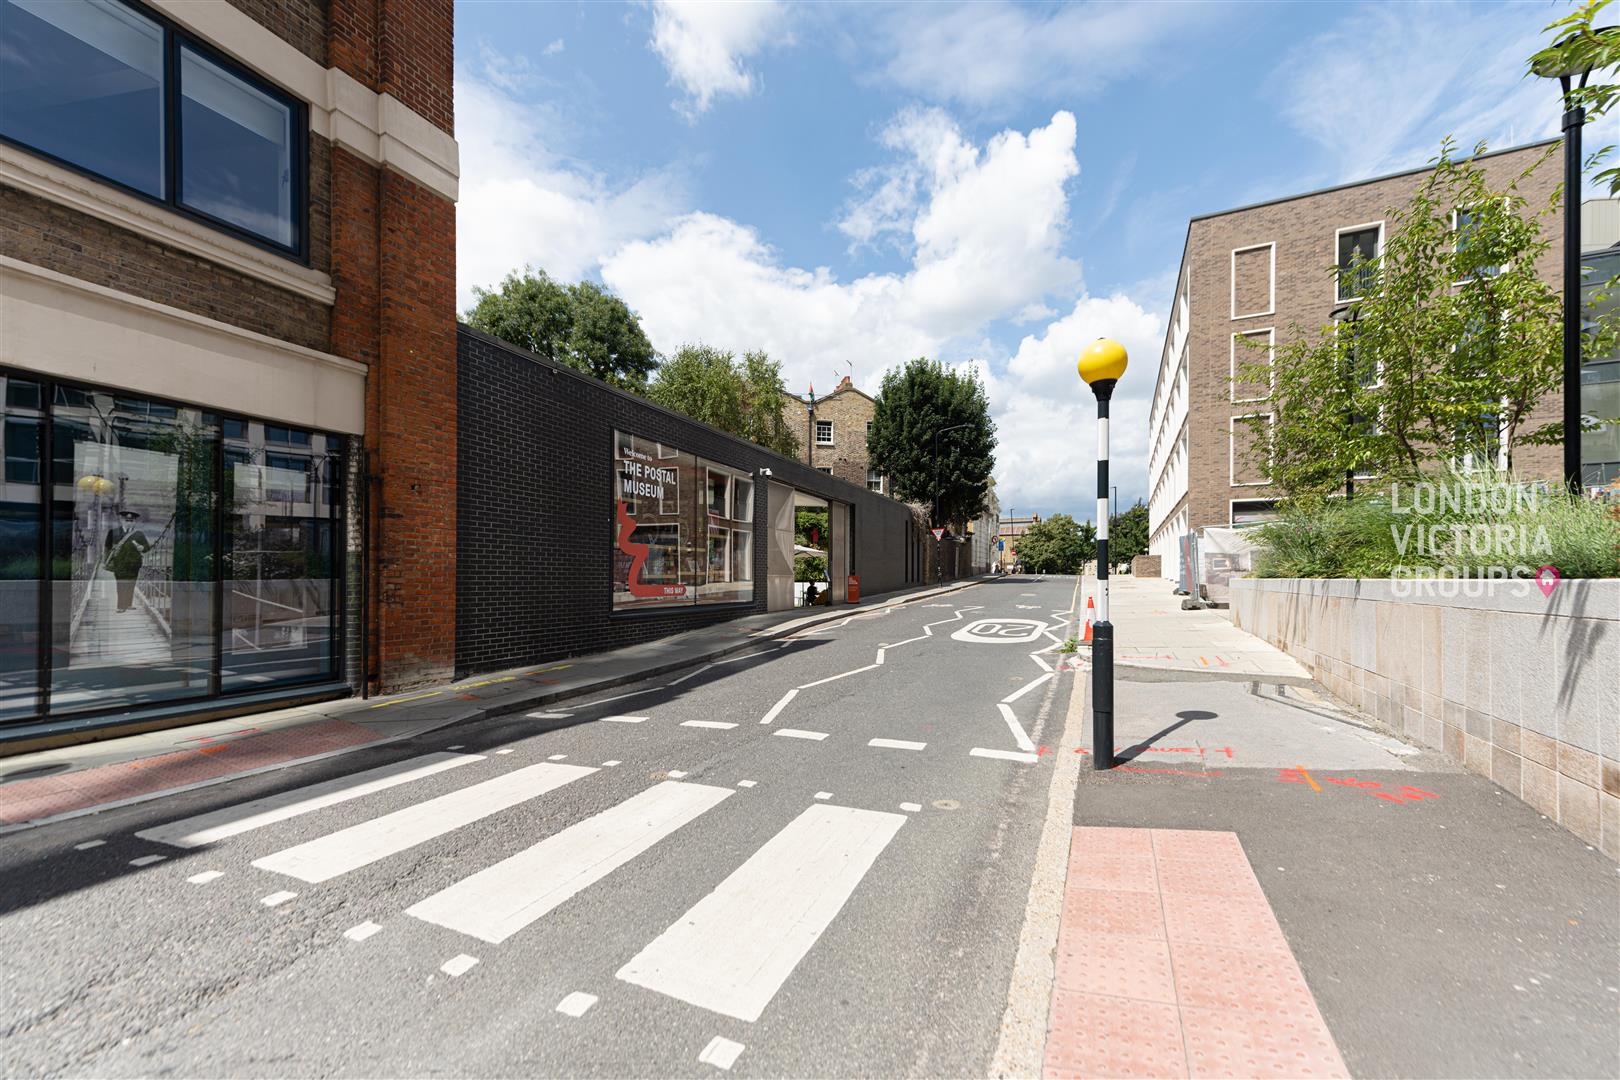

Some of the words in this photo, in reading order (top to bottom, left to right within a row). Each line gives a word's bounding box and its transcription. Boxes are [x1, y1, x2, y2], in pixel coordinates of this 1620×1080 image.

[623, 447, 647, 461] Welcome
[623, 460, 642, 477] THE
[644, 465, 676, 485] POSTAL
[623, 479, 664, 499] MUSEUM
